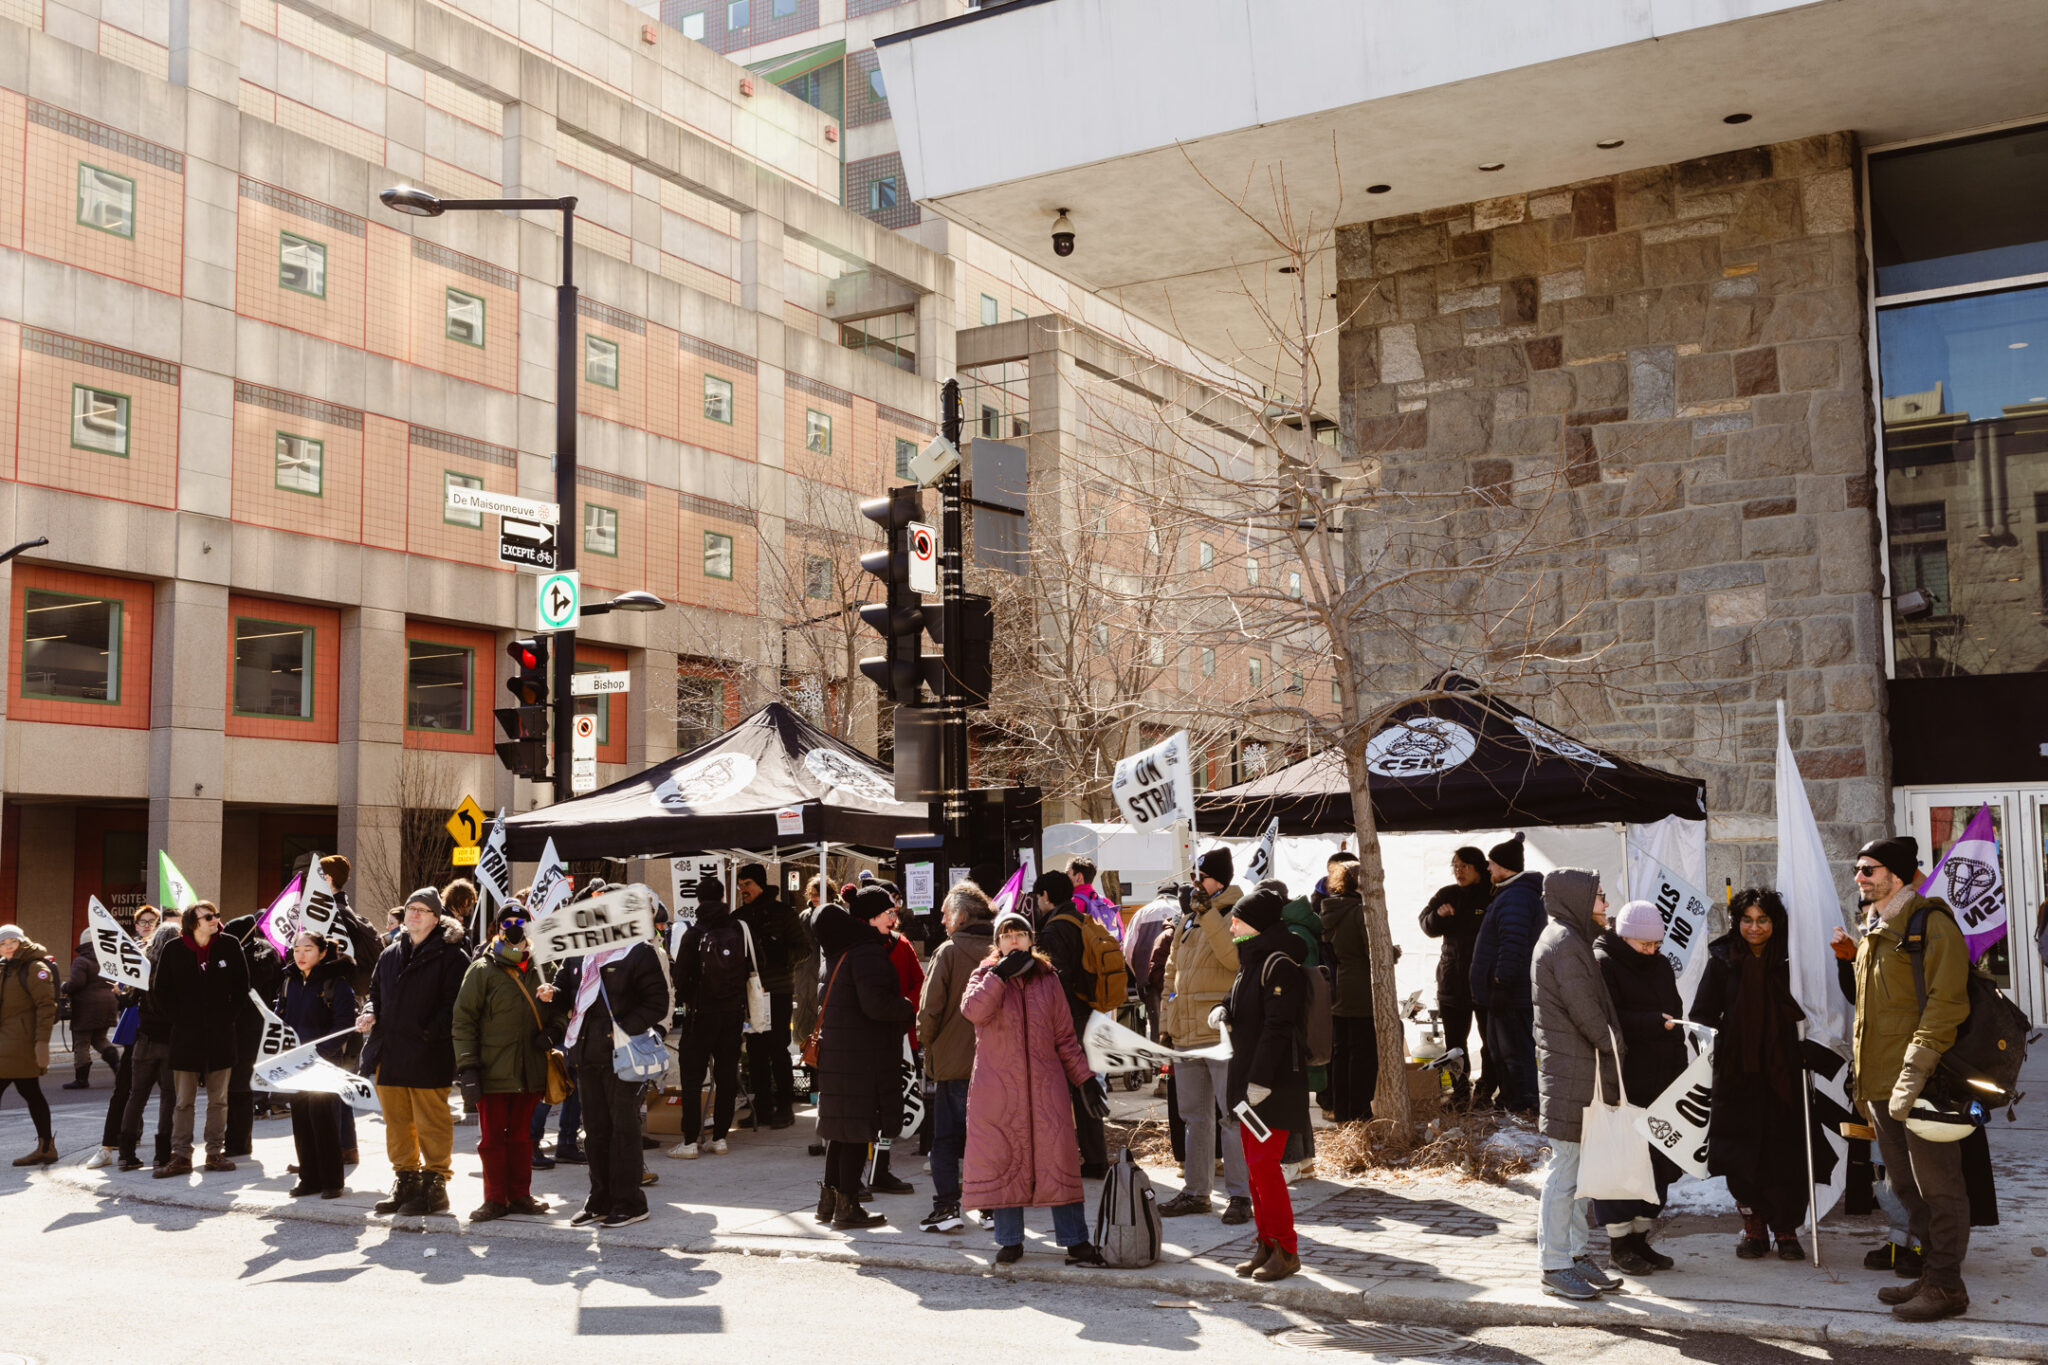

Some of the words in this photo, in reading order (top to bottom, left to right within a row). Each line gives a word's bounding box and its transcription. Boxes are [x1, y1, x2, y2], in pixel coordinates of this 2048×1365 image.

[453, 493, 468, 505] De
[470, 496, 535, 517] Maisonneuve
[502, 544, 536, 560] EXCEPTÉ
[593, 679, 625, 691] Bishop
[1379, 757, 1446, 771] CSN
[111, 893, 147, 905] VISITES
[679, 879, 698, 899] ON
[306, 890, 335, 923] ON
[575, 905, 609, 929] ON
[97, 928, 119, 955] ON
[551, 920, 642, 953] STRIKE
[1669, 916, 1693, 950] ON
[262, 1022, 282, 1055] ON
[1663, 1130, 1683, 1149] CSN
